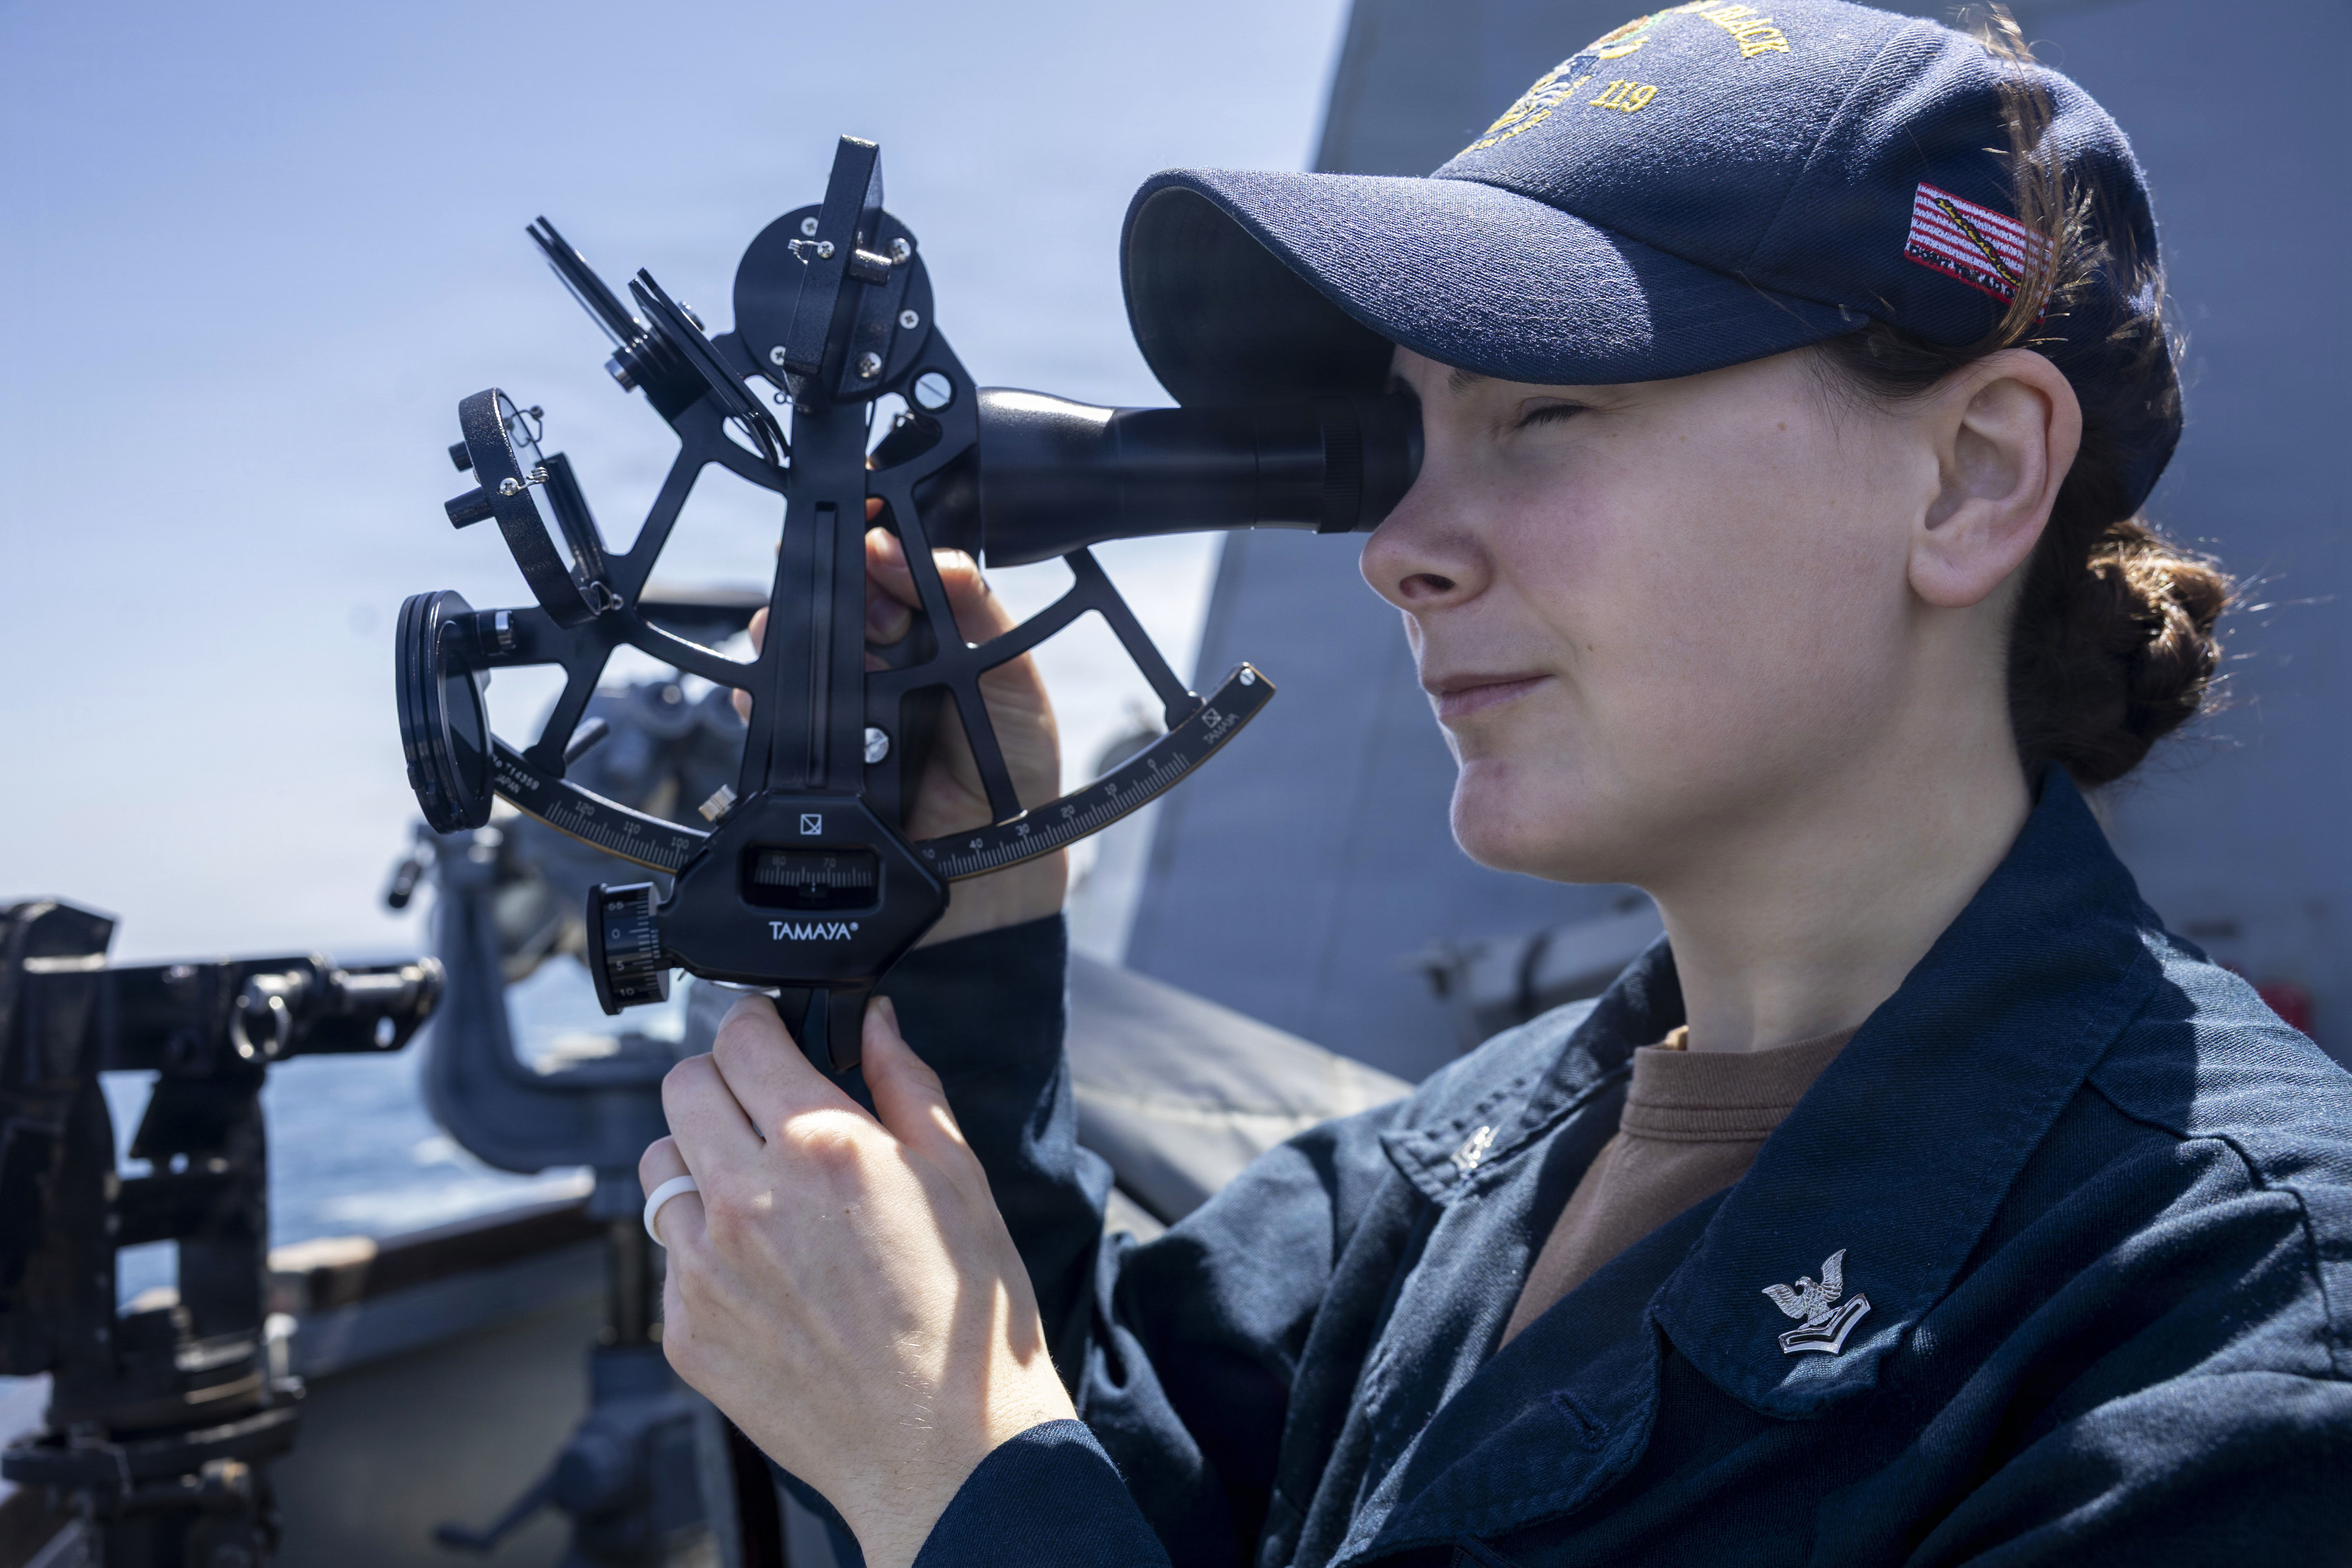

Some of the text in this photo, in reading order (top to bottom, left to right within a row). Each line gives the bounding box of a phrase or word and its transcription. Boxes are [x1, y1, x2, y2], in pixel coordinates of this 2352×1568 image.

[1699, 4, 1791, 58] BLACK
[1589, 79, 1658, 113] 119
[1202, 713, 1240, 744] TAMAYA
[494, 773, 521, 794] JAPAN
[969, 838, 983, 848] 40
[1015, 823, 1030, 836] 30
[1060, 804, 1075, 818] 20
[1104, 783, 1117, 796] 10
[1147, 758, 1156, 768] 0
[575, 800, 690, 849] 120 110 100
[771, 855, 836, 868] 80 70
[608, 901, 624, 911] 55
[612, 928, 620, 939] 0
[616, 960, 624, 971] 5
[620, 987, 635, 996] 10
